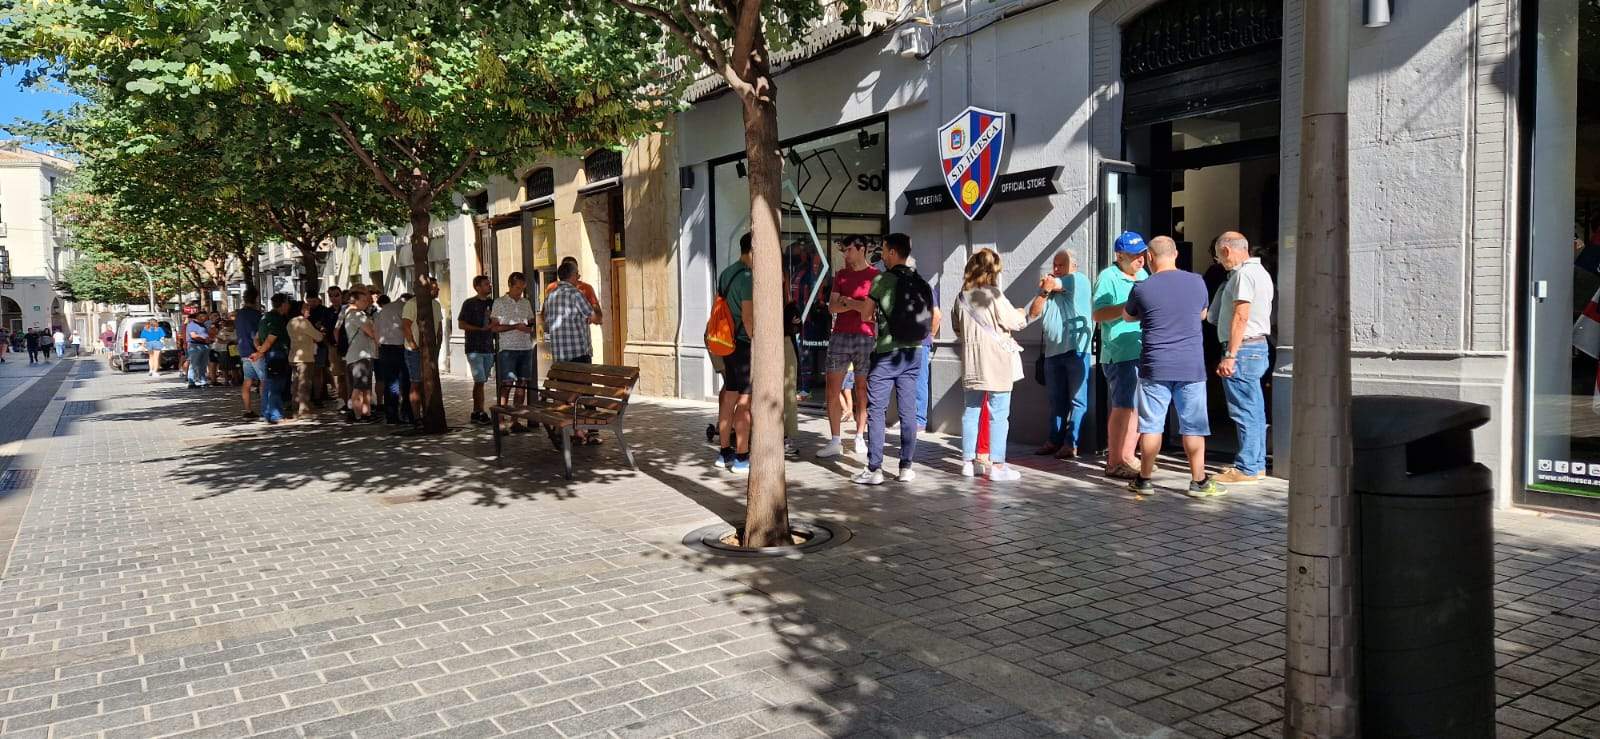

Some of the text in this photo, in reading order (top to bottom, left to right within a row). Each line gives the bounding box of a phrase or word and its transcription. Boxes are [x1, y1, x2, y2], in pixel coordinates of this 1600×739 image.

[966, 125, 999, 163] HUESCA
[1001, 177, 1047, 193] OFFICIAL STORE
[915, 193, 943, 206] TICKETING
